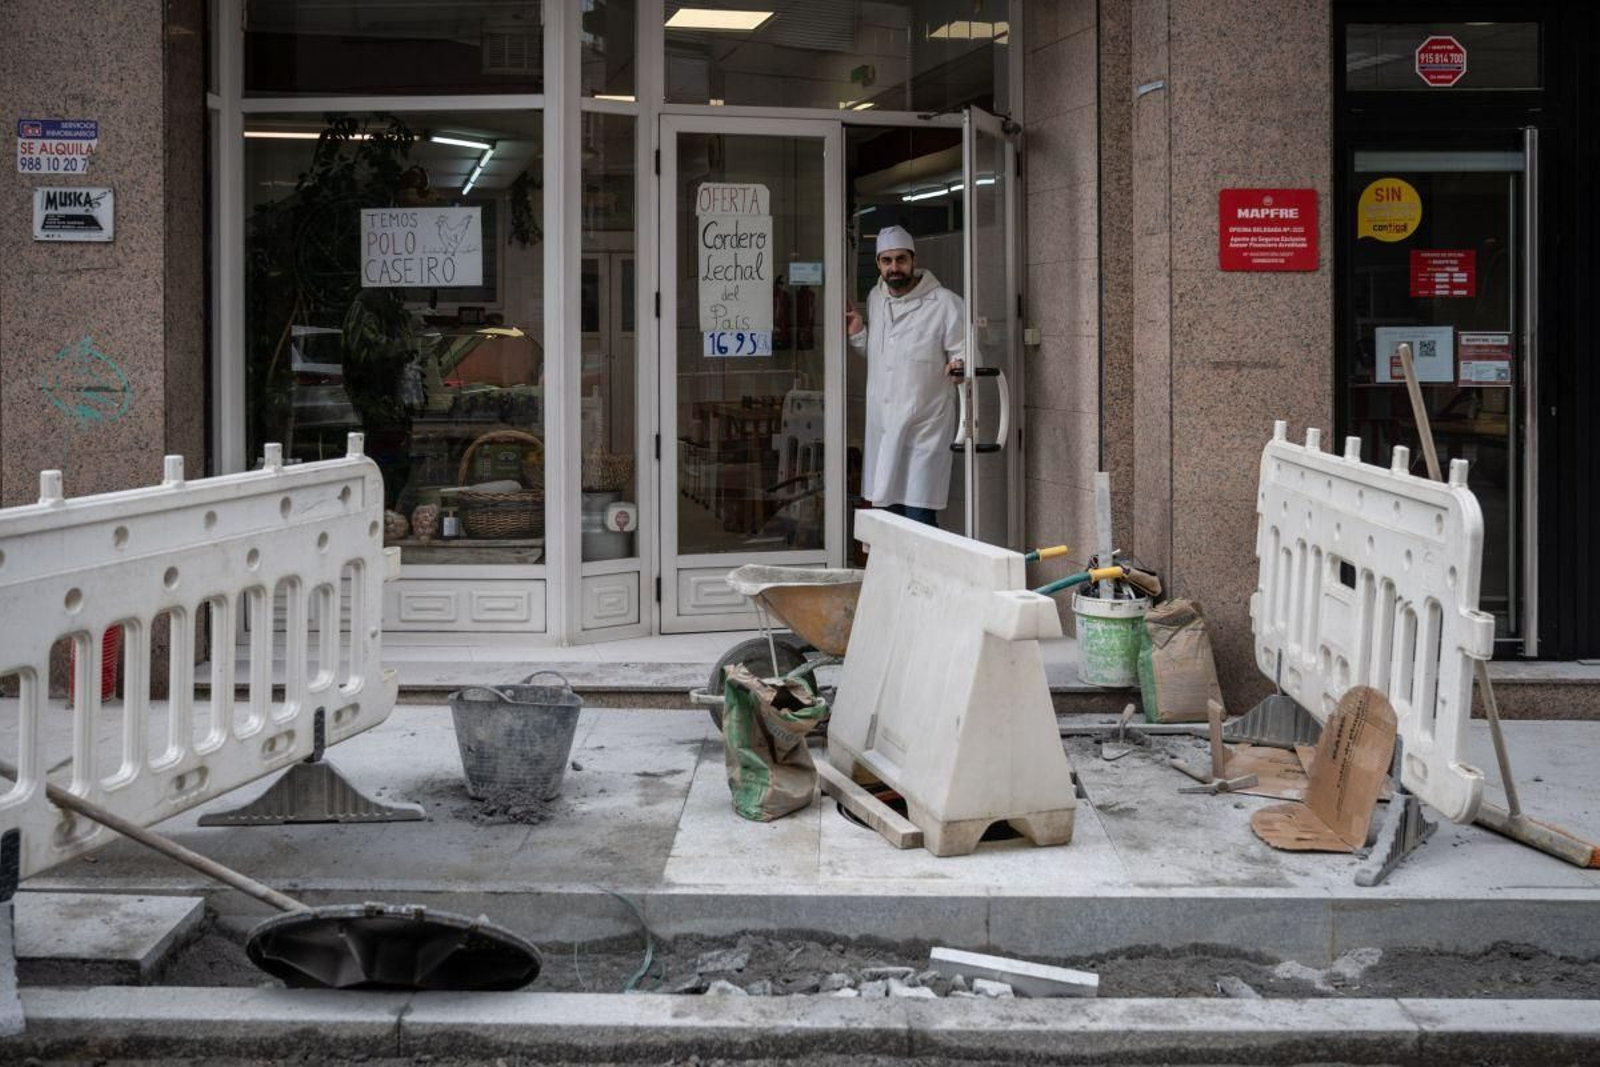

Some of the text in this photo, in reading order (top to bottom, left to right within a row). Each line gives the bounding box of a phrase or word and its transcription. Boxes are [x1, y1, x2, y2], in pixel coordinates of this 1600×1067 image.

[1450, 52, 1463, 64] 700
[20, 142, 94, 156] SE ALQUILA
[20, 157, 41, 171] 988
[47, 158, 59, 171] 10
[63, 158, 77, 171] 20
[700, 187, 761, 214] OFERTA
[1375, 187, 1402, 202] SIN
[366, 213, 418, 228] TEMOS
[1236, 207, 1300, 219] MAPFRE
[702, 220, 767, 250] Cordero
[367, 231, 416, 256] POLO
[365, 257, 455, 284] CASEIRO
[701, 251, 765, 282] Lechal
[721, 285, 739, 301] del
